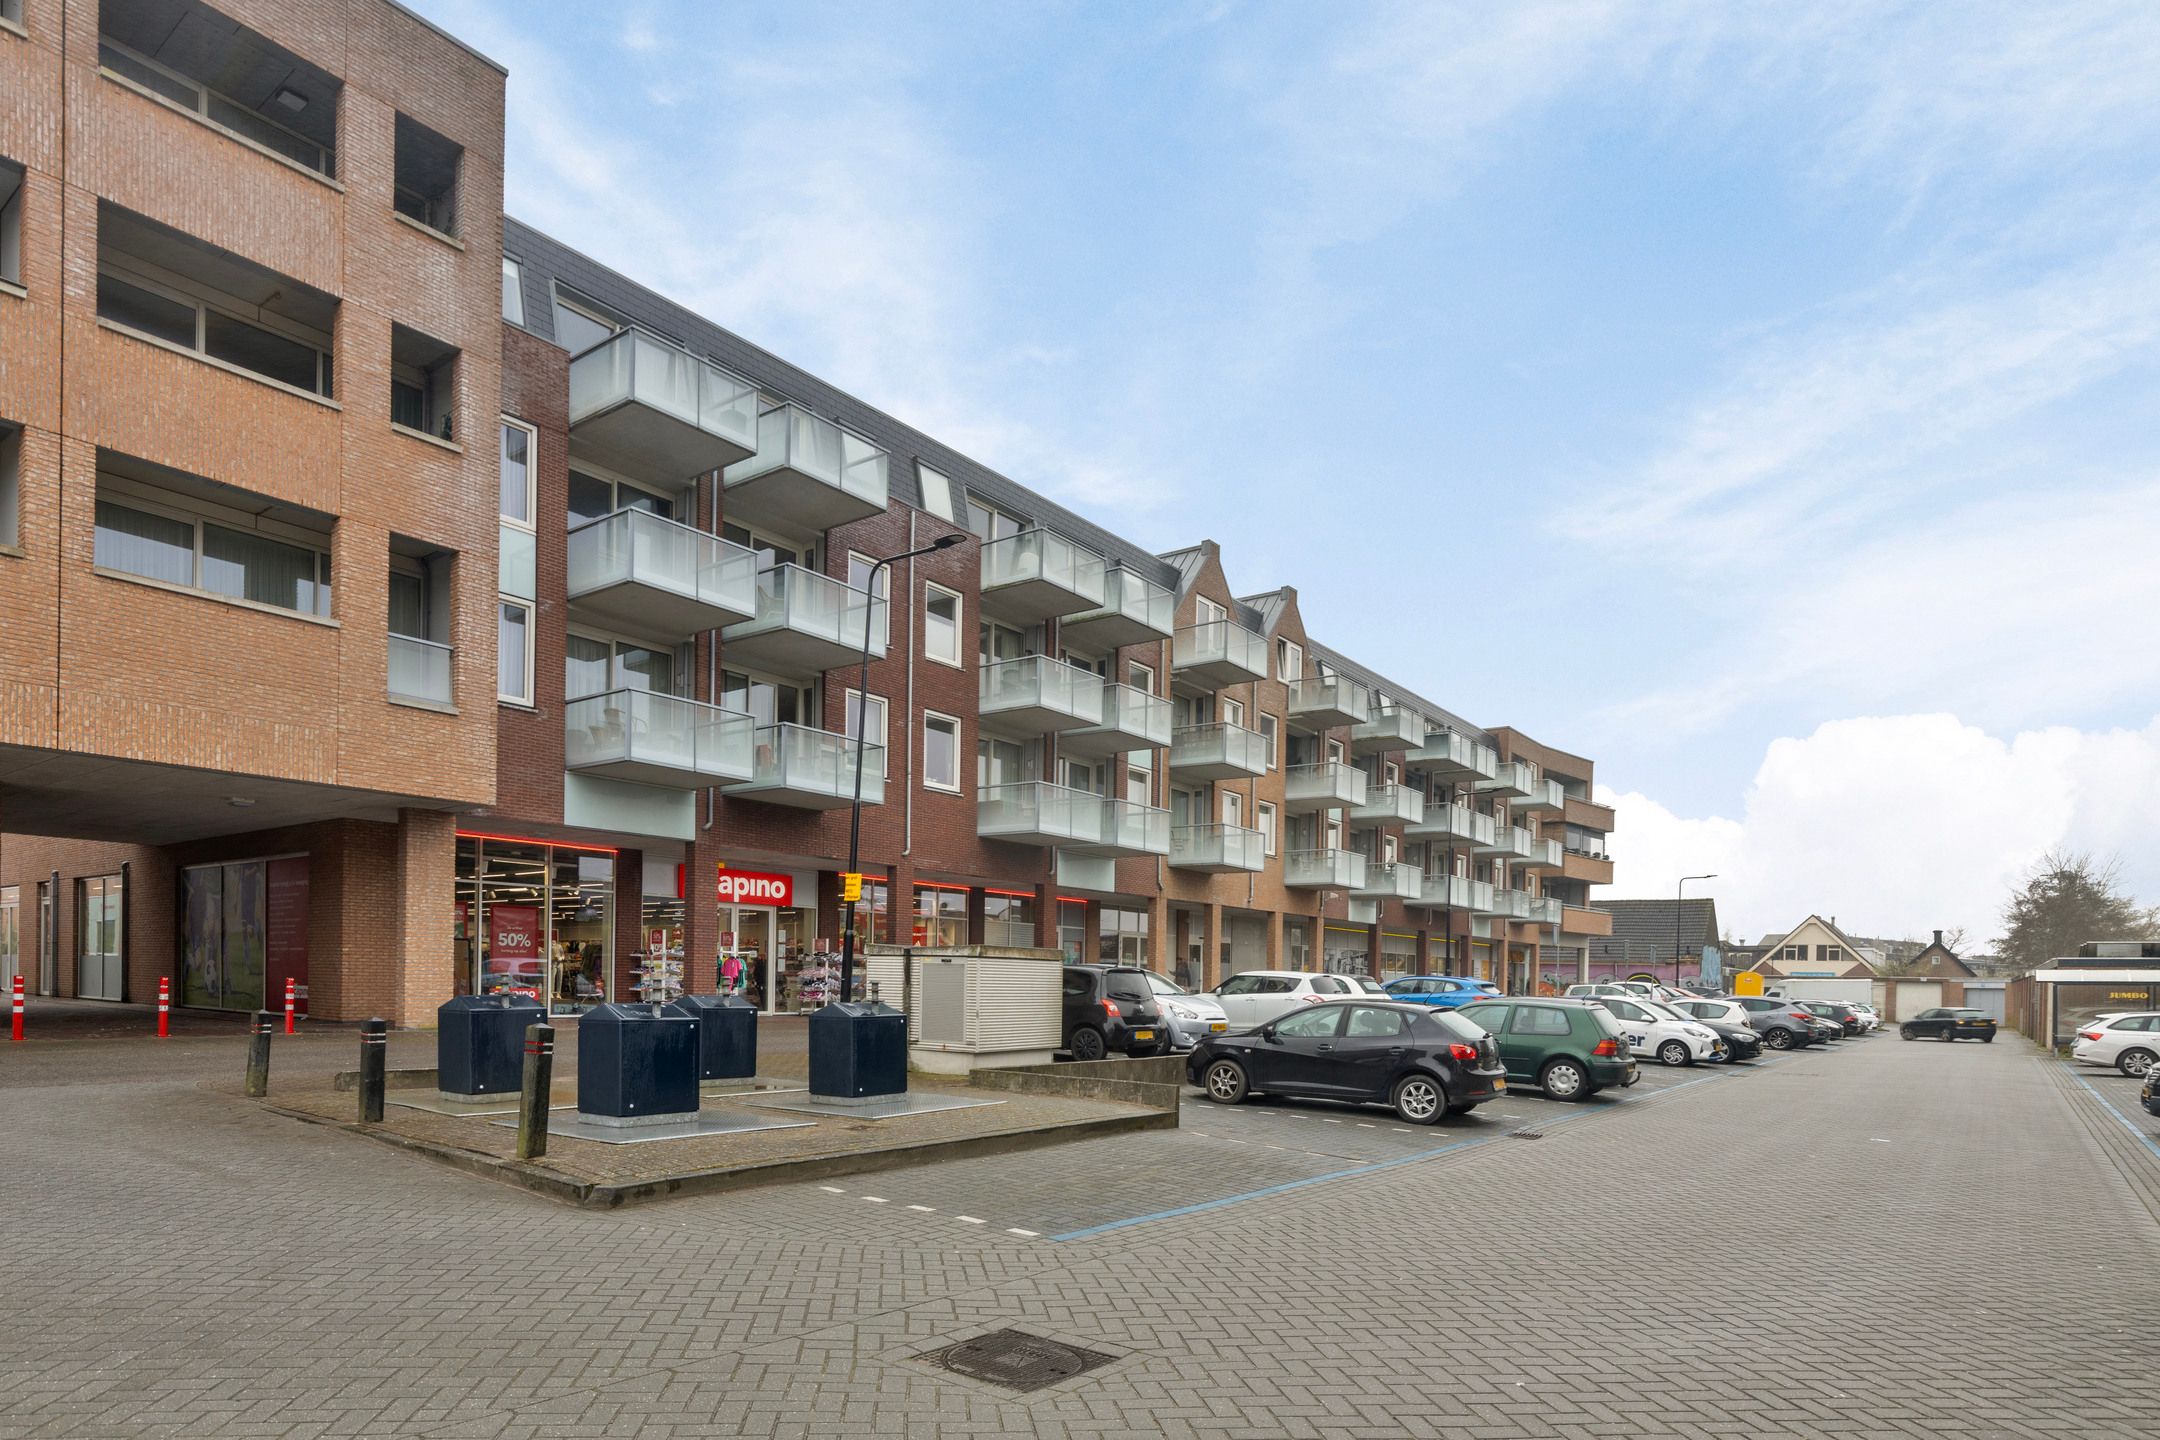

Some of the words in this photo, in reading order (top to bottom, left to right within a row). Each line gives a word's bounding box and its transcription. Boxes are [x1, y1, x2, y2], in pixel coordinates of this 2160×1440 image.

[718, 875, 786, 903] apino
[498, 932, 532, 948] 50%
[2109, 991, 2149, 999] JUMBO
[1628, 1034, 1646, 1047] er
